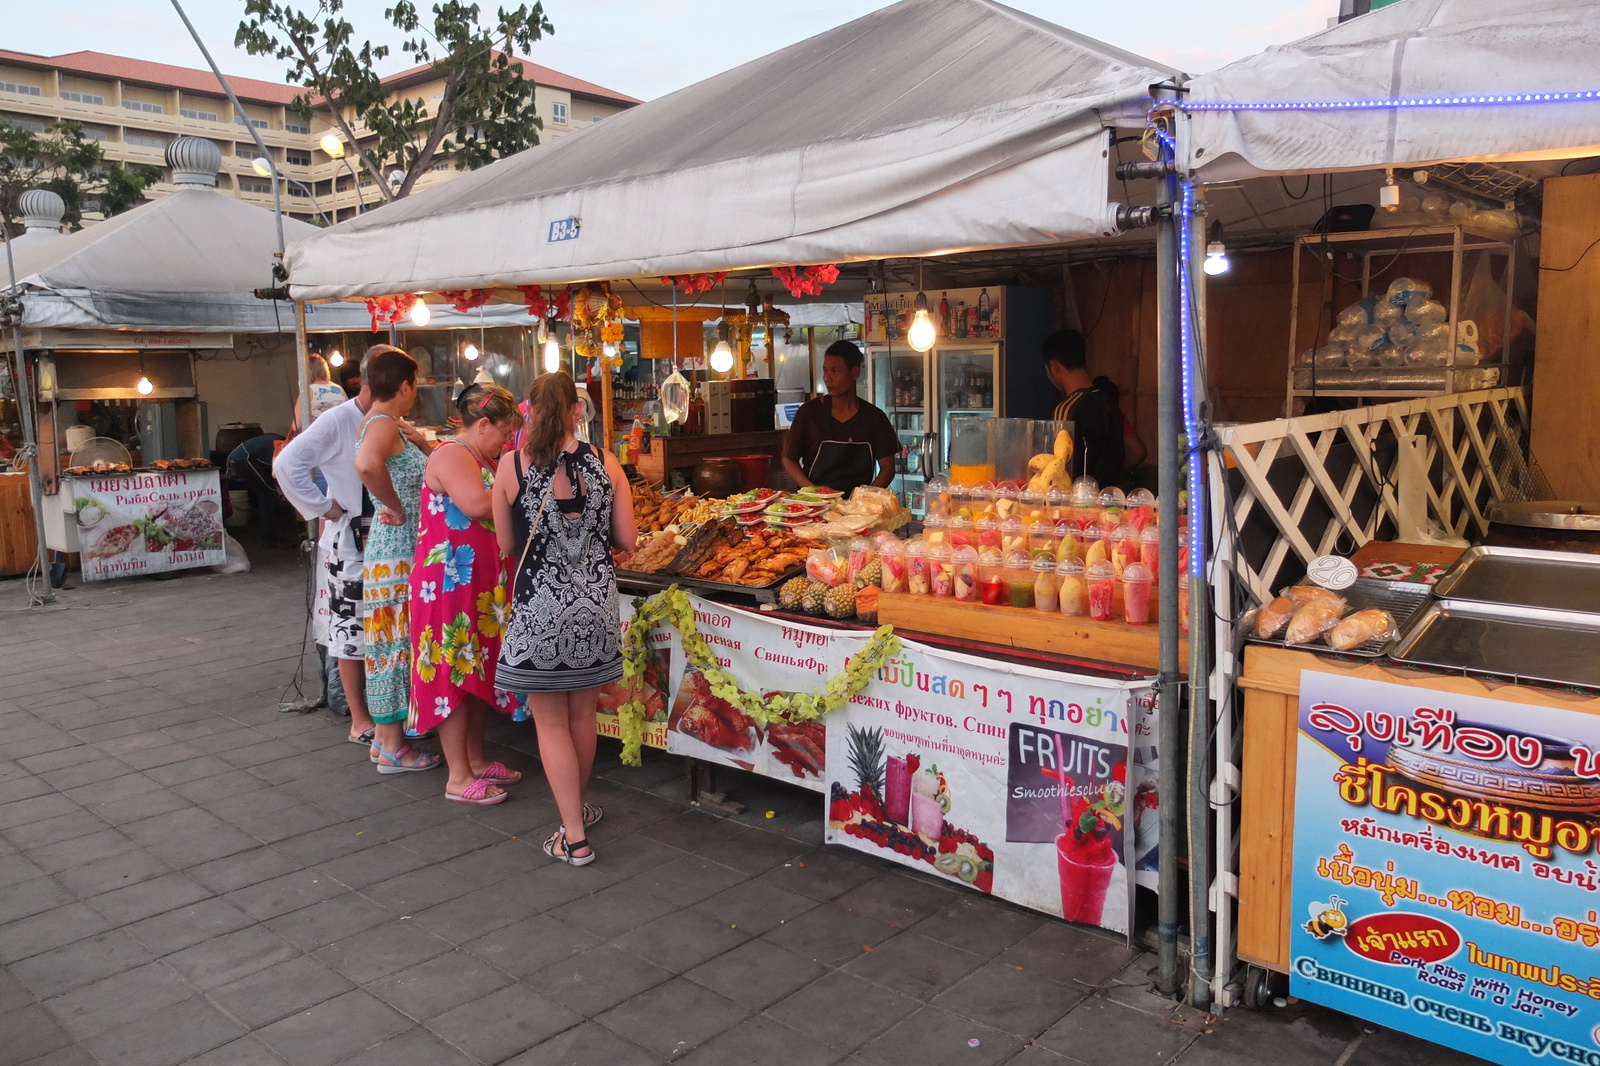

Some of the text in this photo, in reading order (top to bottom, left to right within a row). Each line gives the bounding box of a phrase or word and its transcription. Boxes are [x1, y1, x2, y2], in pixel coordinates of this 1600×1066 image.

[551, 218, 578, 241] B3-5
[1309, 555, 1355, 588] 20
[754, 646, 828, 675] СвиньяФр
[782, 626, 829, 649] หมูทอ
[1018, 728, 1111, 778] FRUITS
[1309, 704, 1542, 768] ลุงเทือง
[1296, 957, 1407, 1007] Свинина
[1413, 997, 1492, 1033] очень
[1390, 951, 1579, 1017] Pork Ribs with Honey
[1418, 970, 1544, 1018] Roast in a Jar.
